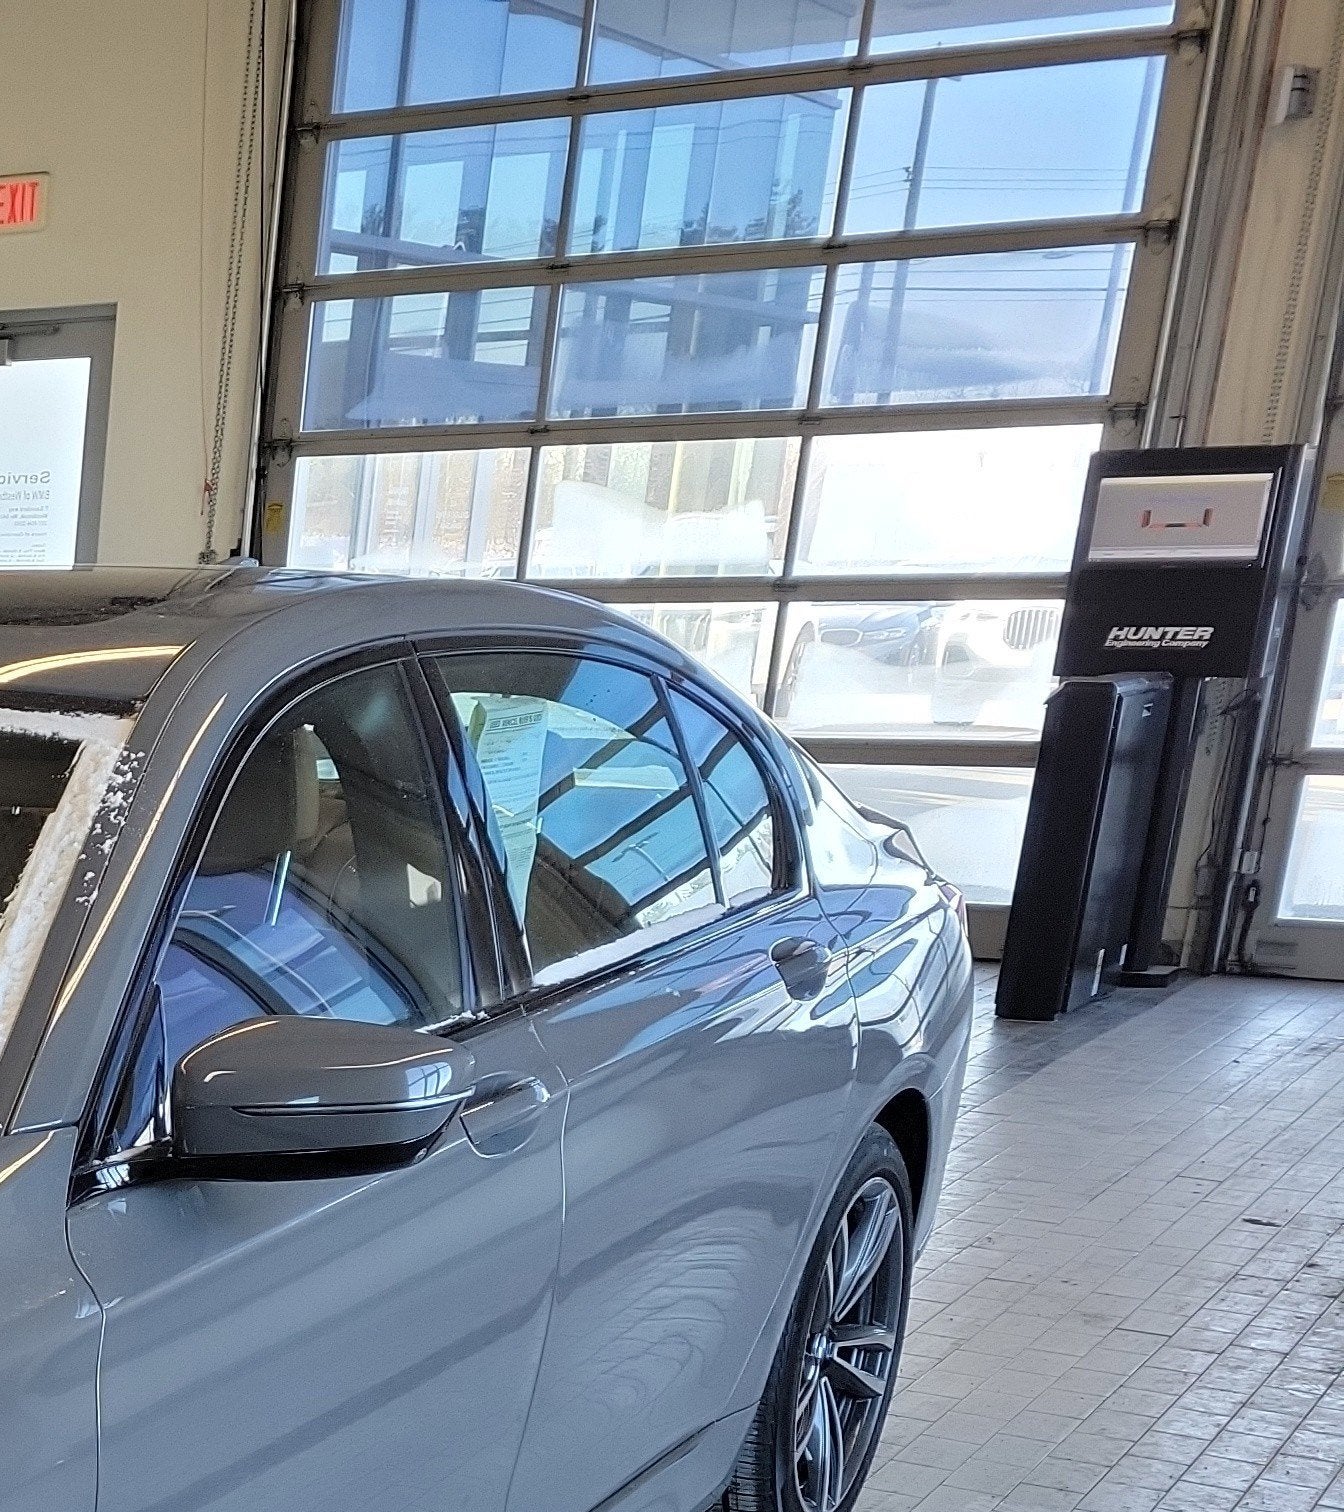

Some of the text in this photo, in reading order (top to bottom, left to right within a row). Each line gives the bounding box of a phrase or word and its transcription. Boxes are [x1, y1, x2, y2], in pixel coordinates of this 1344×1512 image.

[1107, 626, 1215, 640] HUNTER
[1104, 639, 1210, 648] Engineering Company
